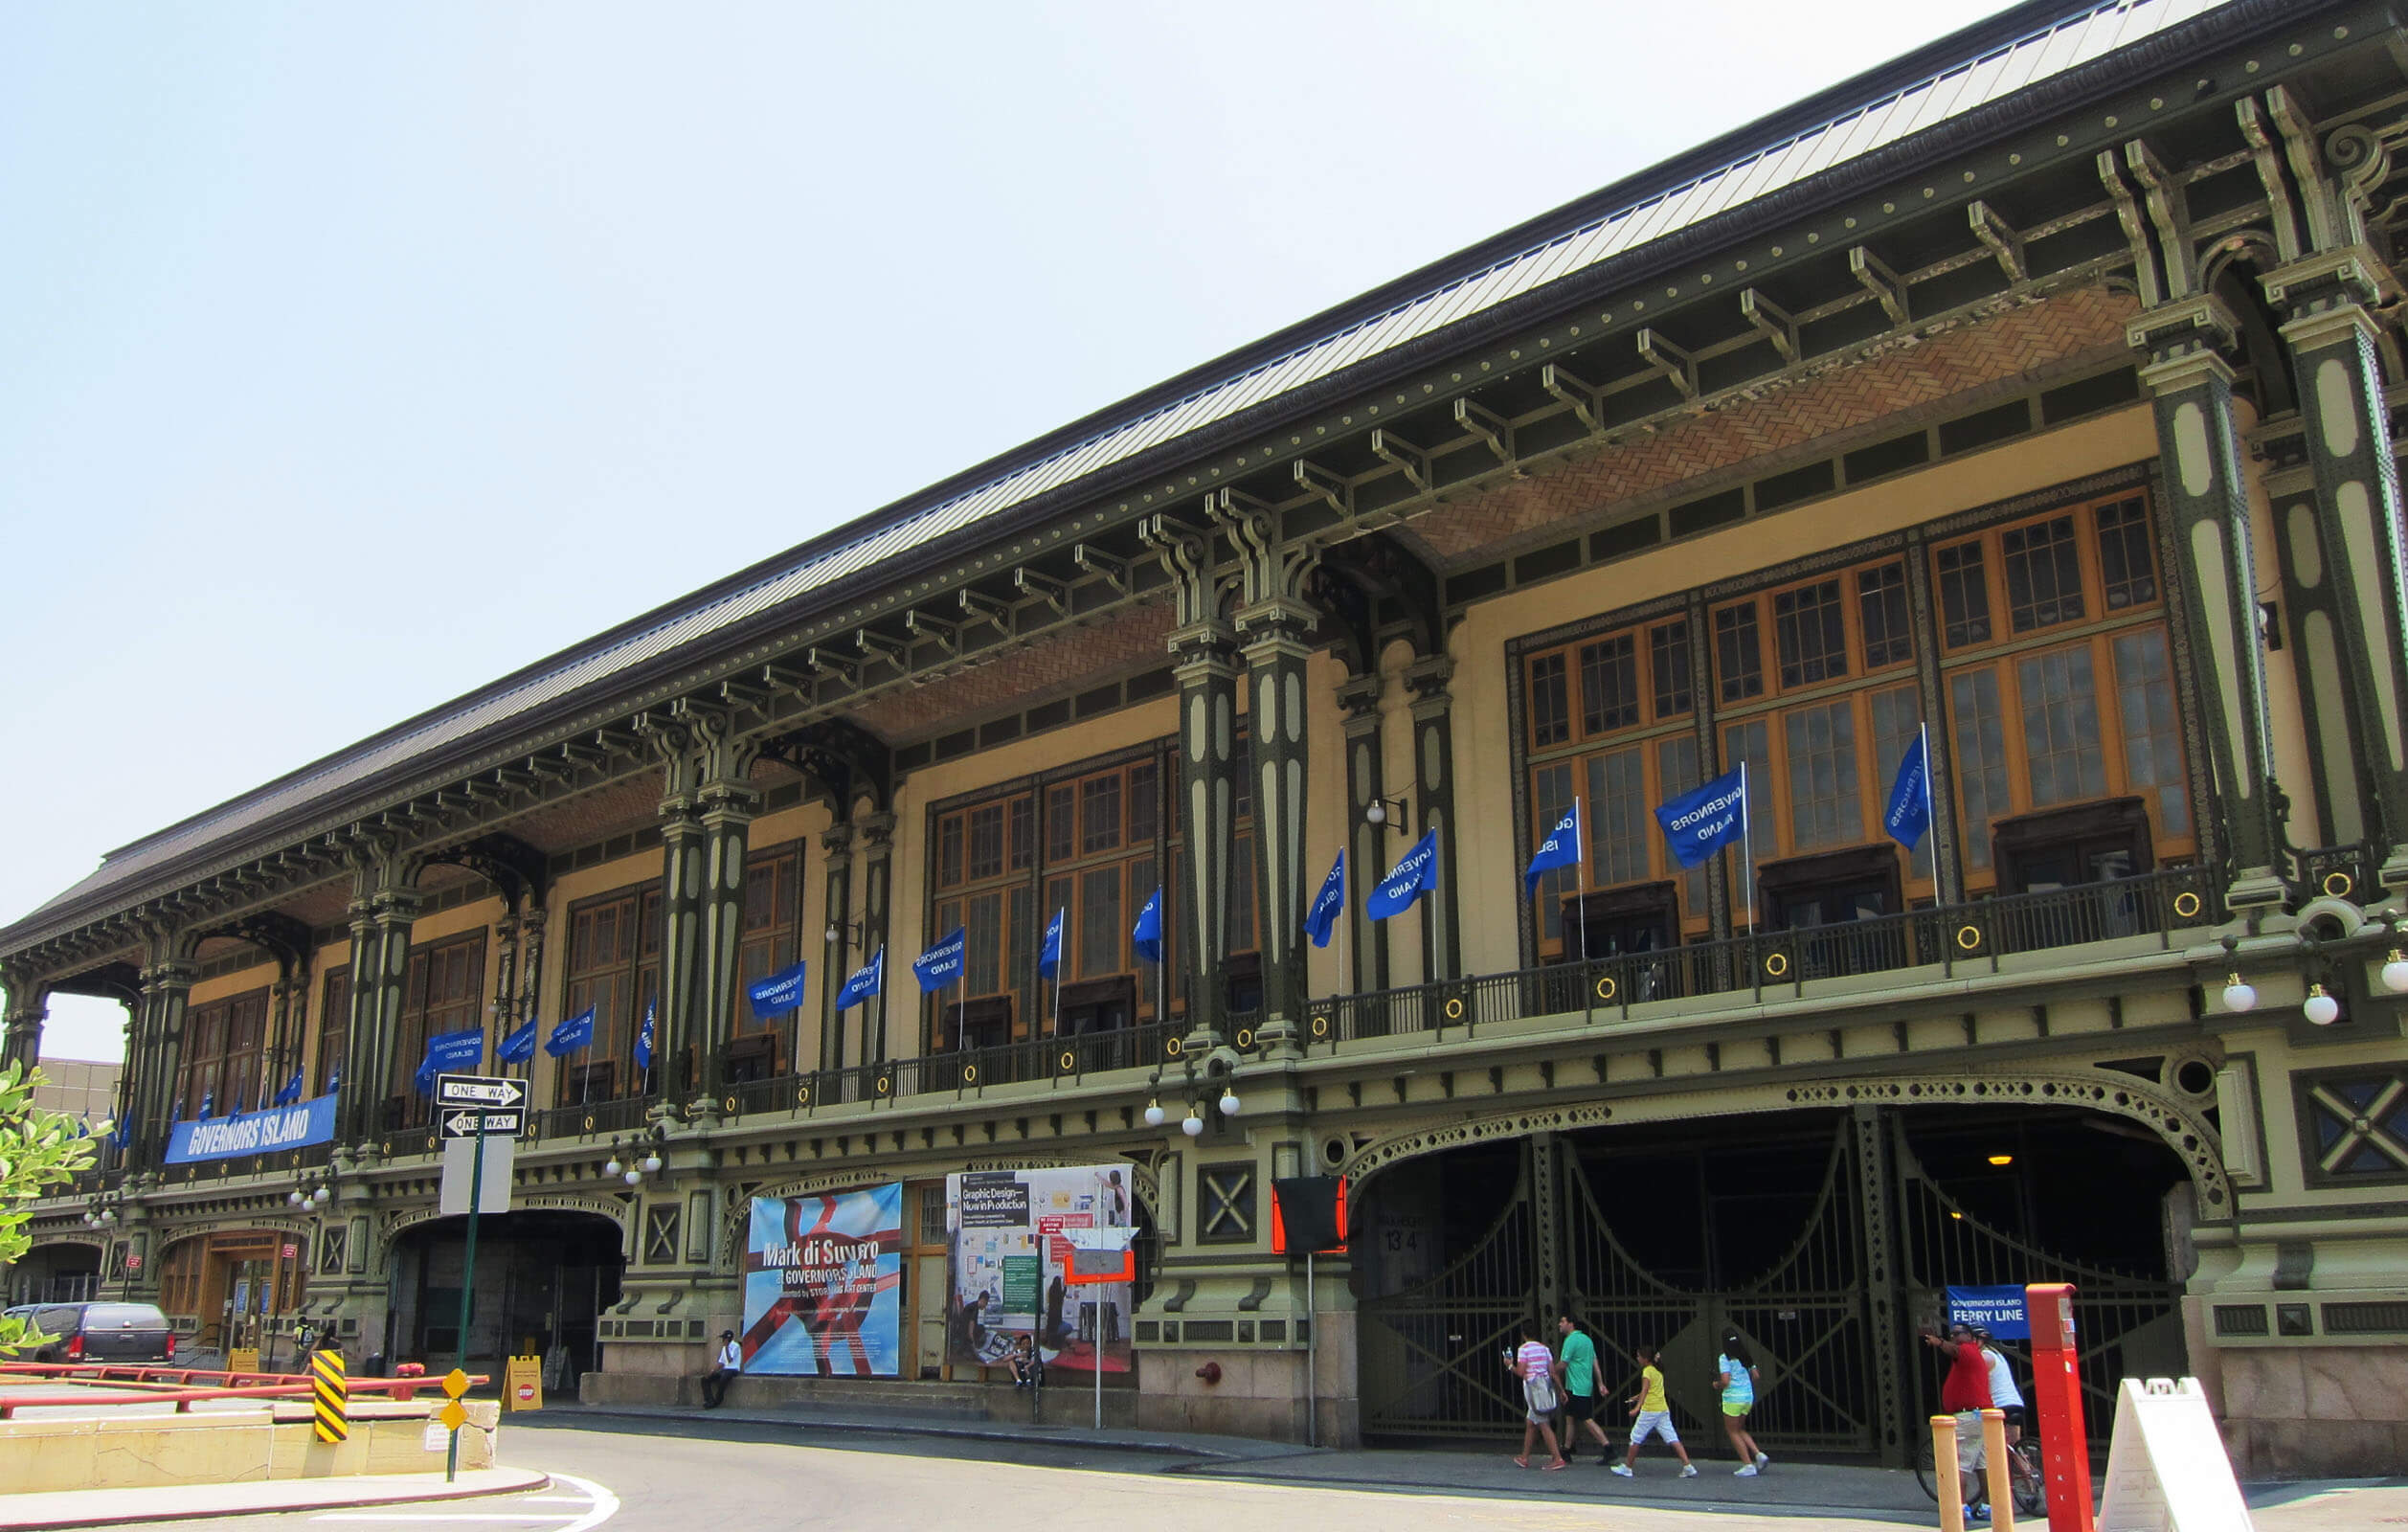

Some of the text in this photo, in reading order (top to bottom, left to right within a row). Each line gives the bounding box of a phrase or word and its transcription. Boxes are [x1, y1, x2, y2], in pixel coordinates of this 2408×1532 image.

[452, 1085, 513, 1099] ONE WAY
[457, 1116, 511, 1129] ONE WAY
[188, 1109, 309, 1156] GOVERNORS ISLAND
[963, 1188, 990, 1201] Graphic
[963, 1200, 979, 1211] Now
[988, 1199, 1026, 1209] Production
[763, 1241, 800, 1266] Mark
[805, 1240, 819, 1265] di
[786, 1268, 847, 1285] GOVERNORS
[1951, 1298, 2022, 1307] GOVERNORS ISLAND
[1953, 1309, 2023, 1321] FERRY LINE
